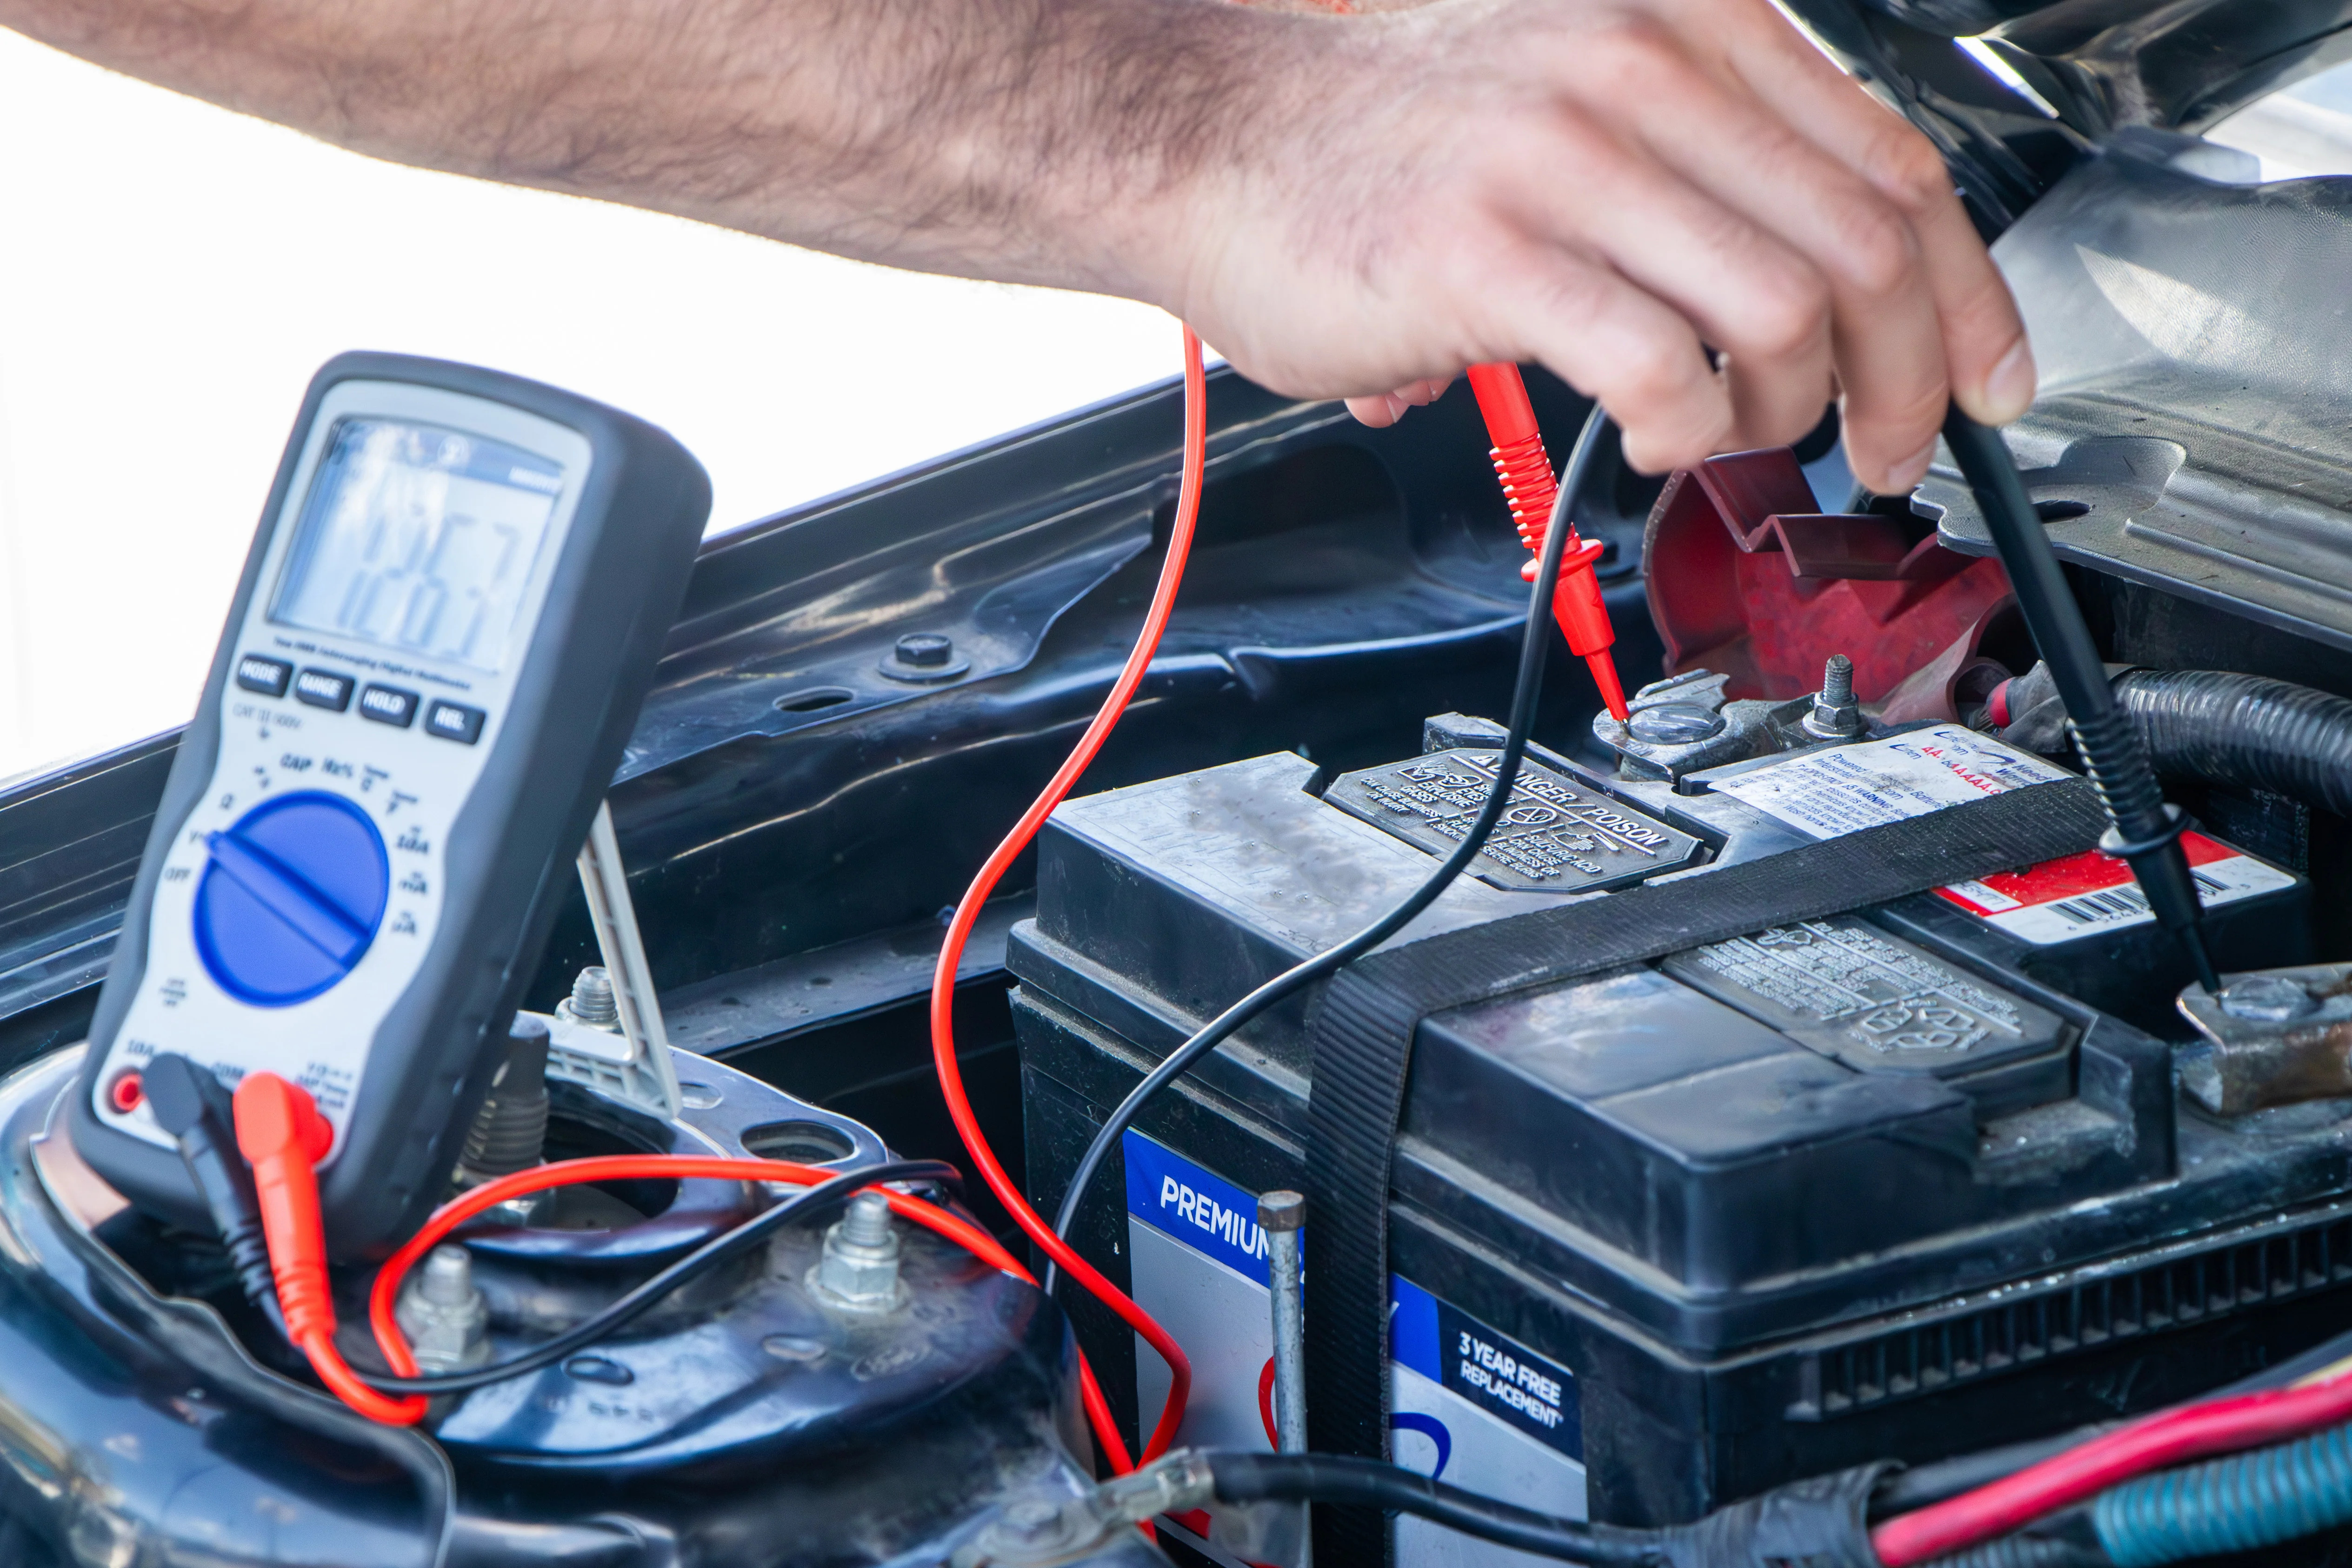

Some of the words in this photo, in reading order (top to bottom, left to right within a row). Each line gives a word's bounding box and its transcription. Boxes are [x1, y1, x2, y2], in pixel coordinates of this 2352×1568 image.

[240, 660, 281, 685] MODE
[298, 672, 342, 698] RANGE
[363, 688, 406, 714] HOLD
[280, 753, 313, 772] CAP
[1828, 754, 1868, 773] Powered
[1366, 791, 1384, 801] OR
[1399, 786, 1438, 803] GASES
[1418, 781, 1477, 807] EXPLOSIVE
[1456, 787, 1489, 801] EYES
[1488, 765, 1579, 804] DNGER
[1581, 808, 1668, 847] POISON
[1853, 787, 1894, 809] WARNING:
[1398, 797, 1443, 819] BLINDNESS
[1482, 846, 1517, 868] SEVERE
[1509, 861, 1543, 879] BURNS
[1493, 842, 1546, 868] BLINDNESS
[1540, 867, 1560, 876] OR
[1509, 839, 1531, 851] CAN
[1527, 848, 1563, 866] CAUSE
[1525, 835, 1578, 861] SULFURIC
[1569, 859, 1602, 874] ACID
[1459, 1331, 1471, 1355] 3
[1472, 1338, 1517, 1383] YEAR
[1517, 1364, 1562, 1408] FREE
